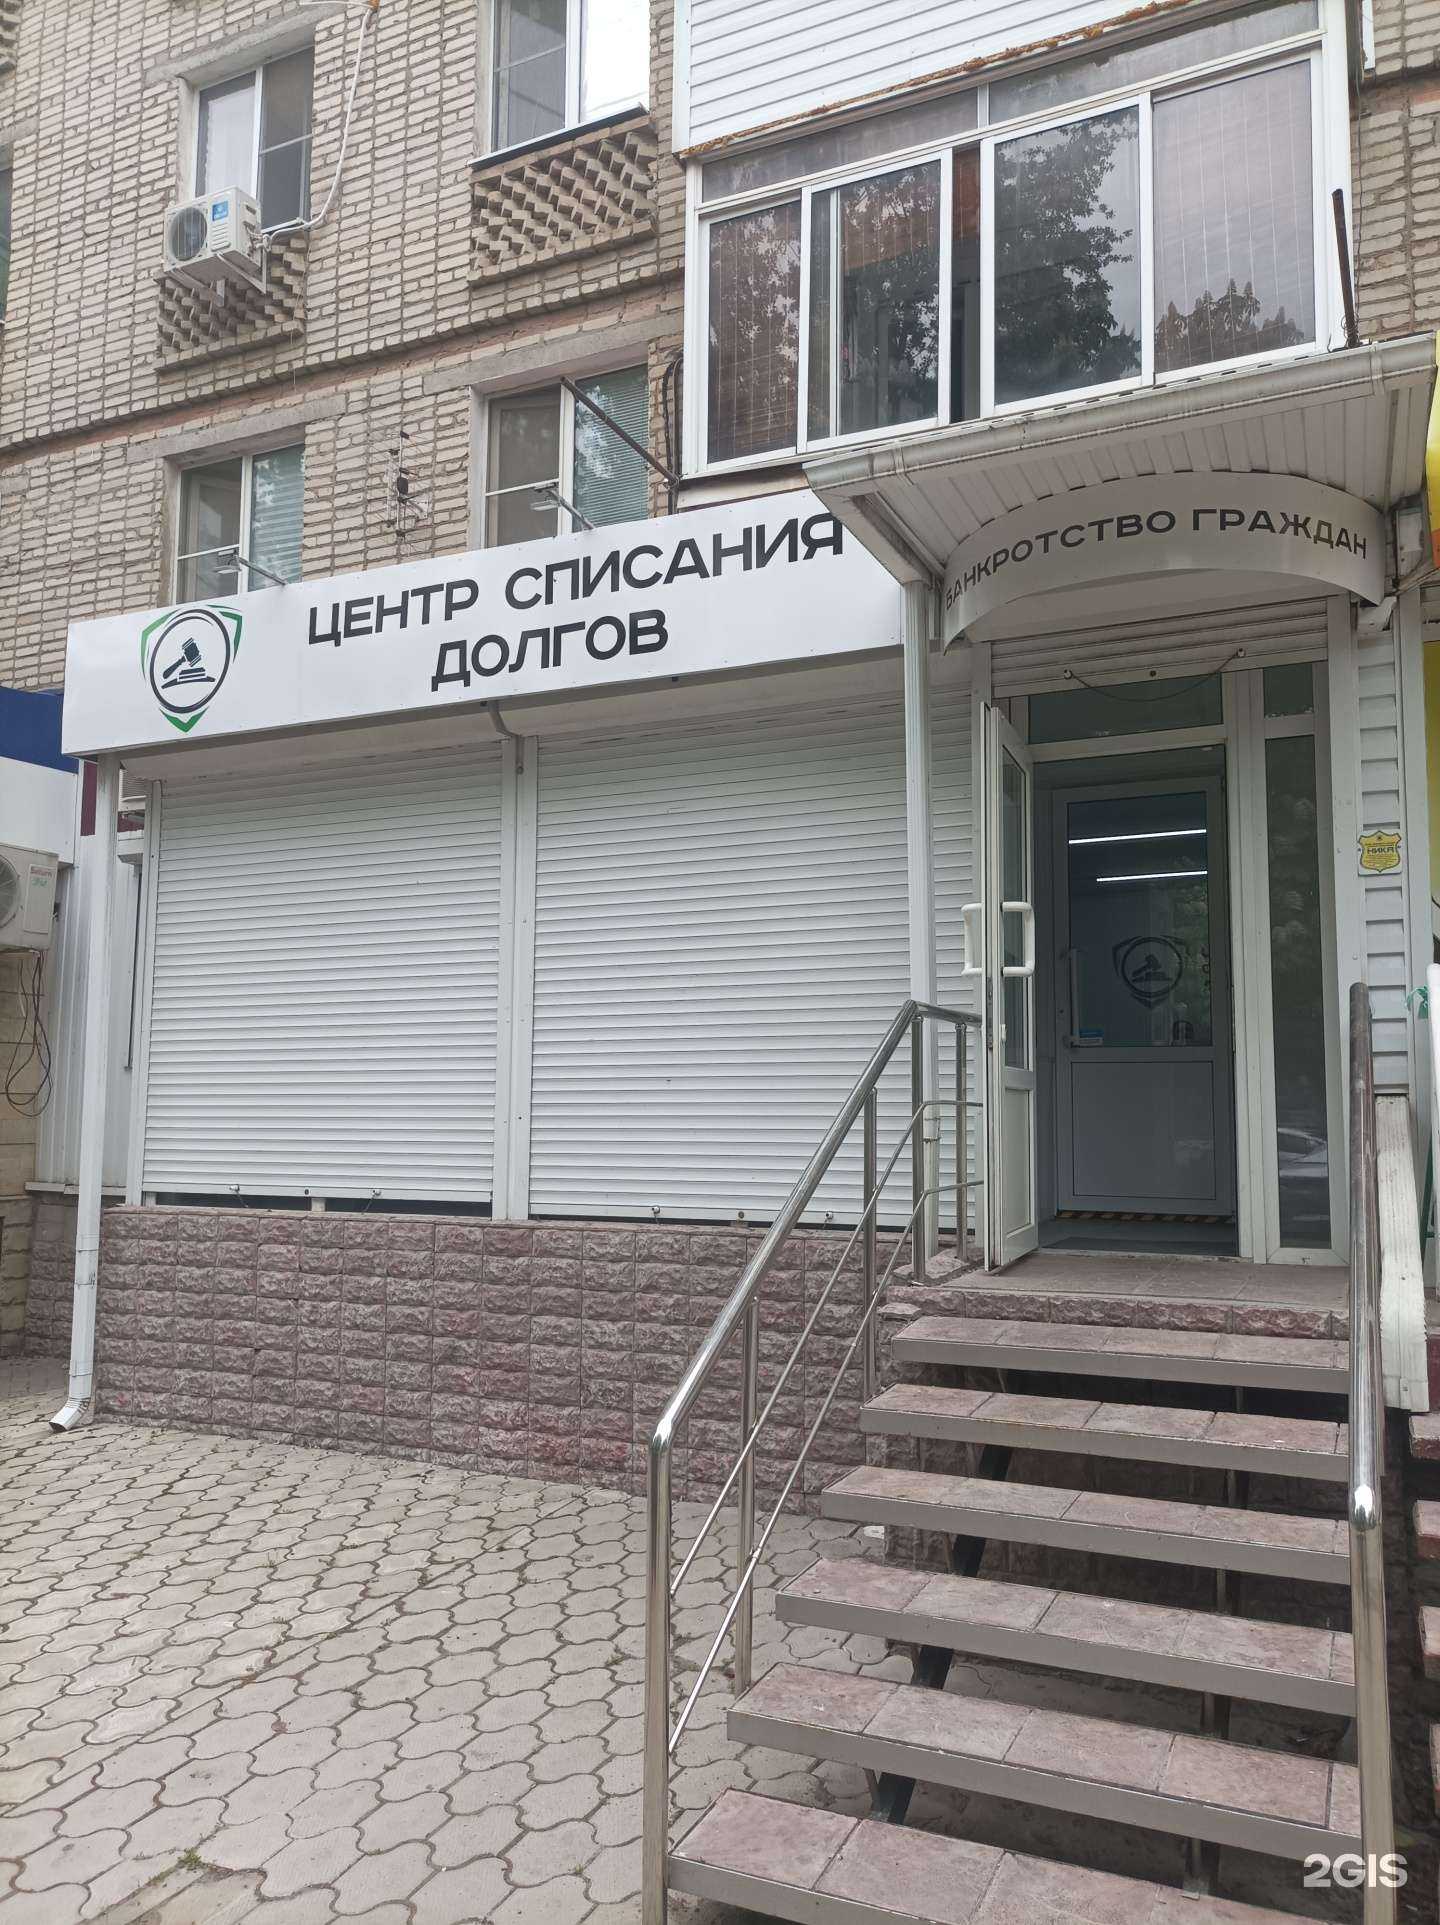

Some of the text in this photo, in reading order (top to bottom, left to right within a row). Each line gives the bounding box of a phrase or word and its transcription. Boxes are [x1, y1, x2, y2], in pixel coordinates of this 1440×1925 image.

[308, 512, 844, 648] ЦЕНТР СПИСАНИЯ
[945, 508, 1368, 611] БАНКРОТСТВО ГРАЖДАН
[431, 609, 669, 692] ДОЛГОВ
